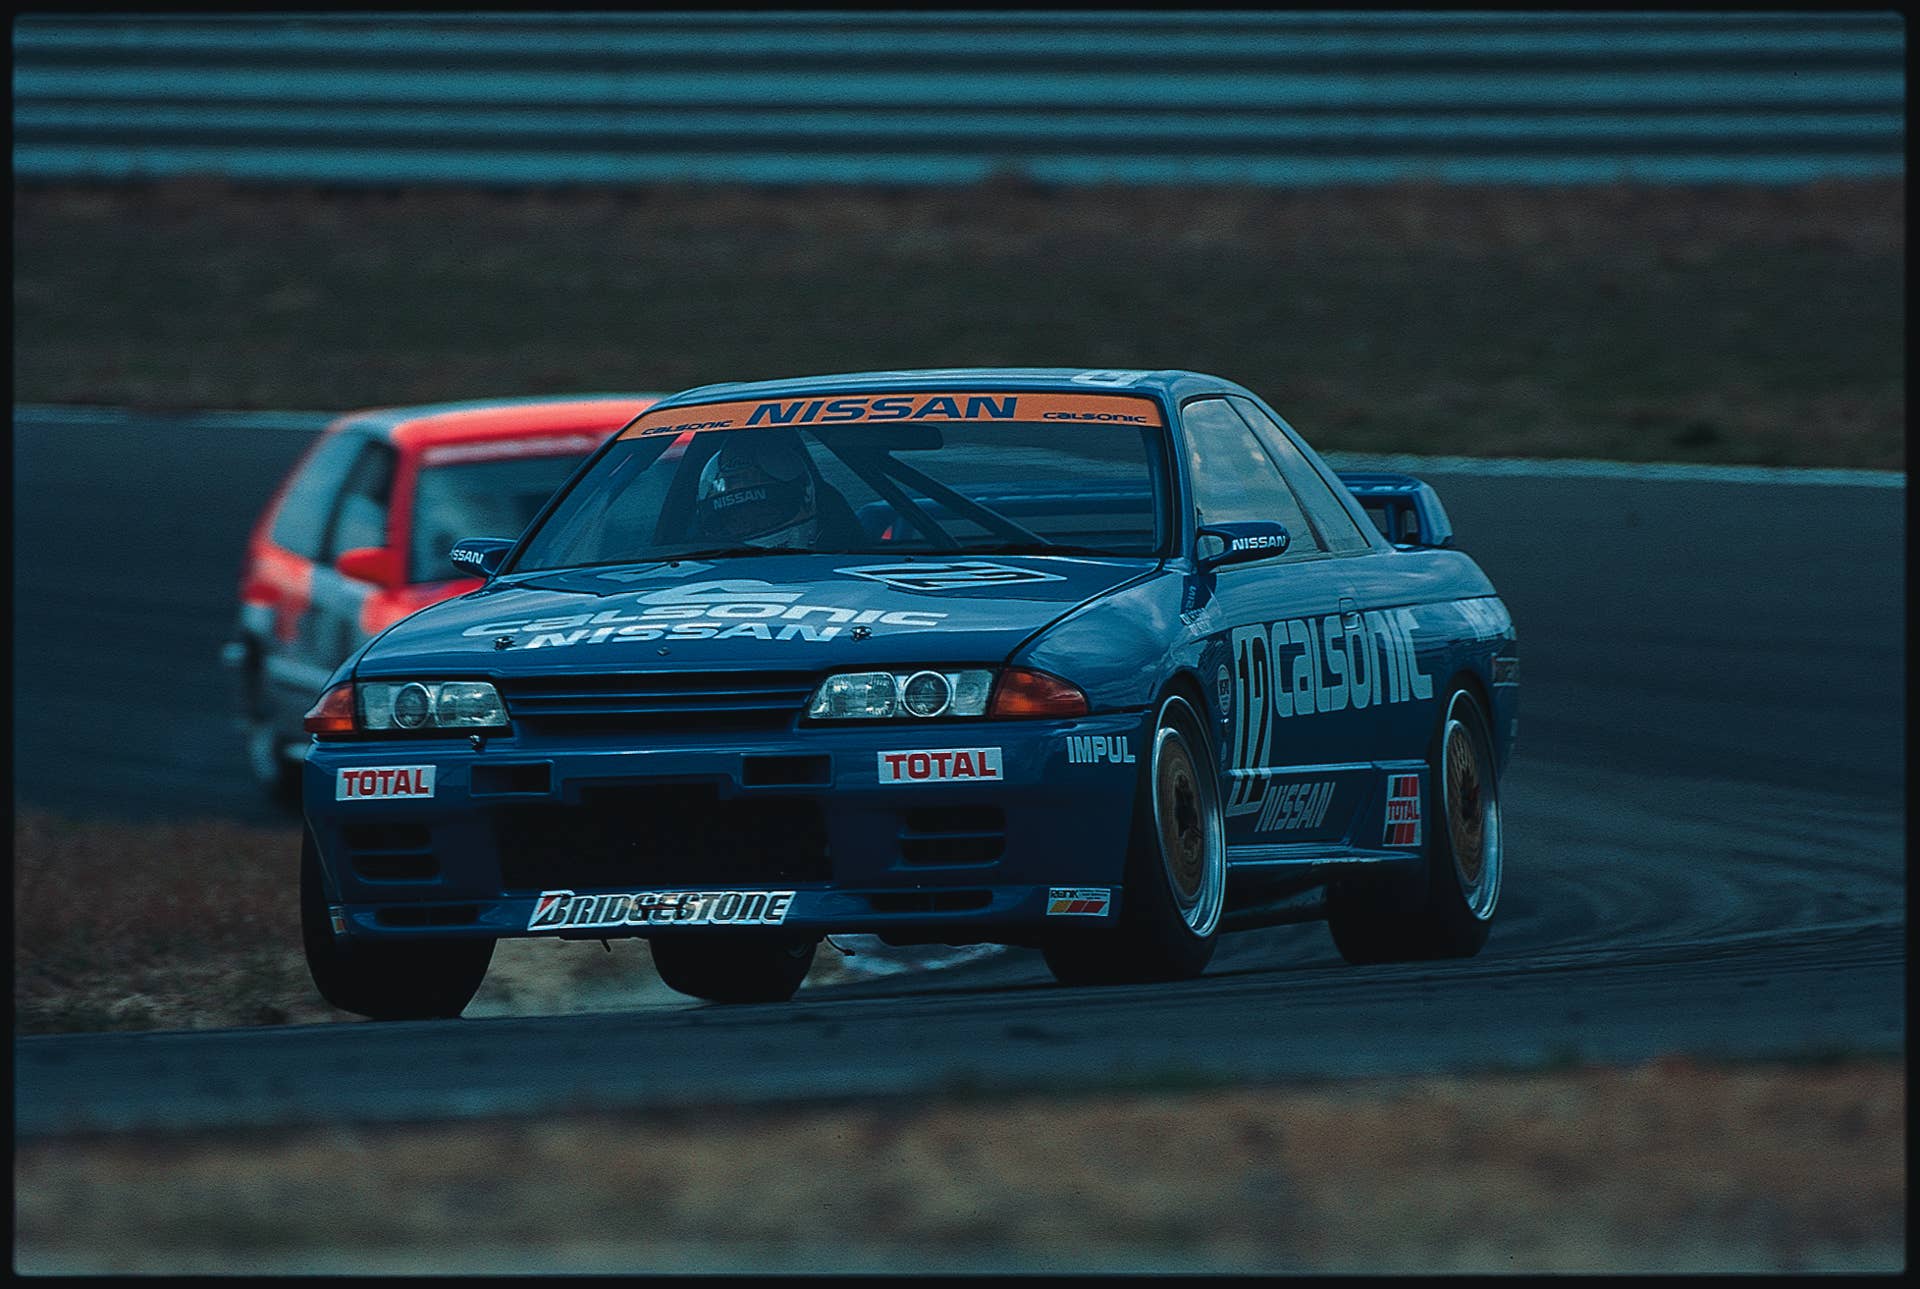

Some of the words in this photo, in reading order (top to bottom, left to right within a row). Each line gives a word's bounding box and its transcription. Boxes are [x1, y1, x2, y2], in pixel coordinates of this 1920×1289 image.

[745, 397, 1017, 425] NISSAN
[712, 488, 767, 511] NISSAN
[1231, 535, 1286, 551] NISSAN
[524, 622, 843, 649] NISSAN
[1067, 736, 1136, 764] IMPUL
[884, 752, 998, 780] TOTAL
[343, 769, 429, 797] TOTAL
[1254, 782, 1336, 832] NISSAN
[1388, 801, 1420, 820] TOTAL
[529, 891, 796, 930] BRIDGESTONE
